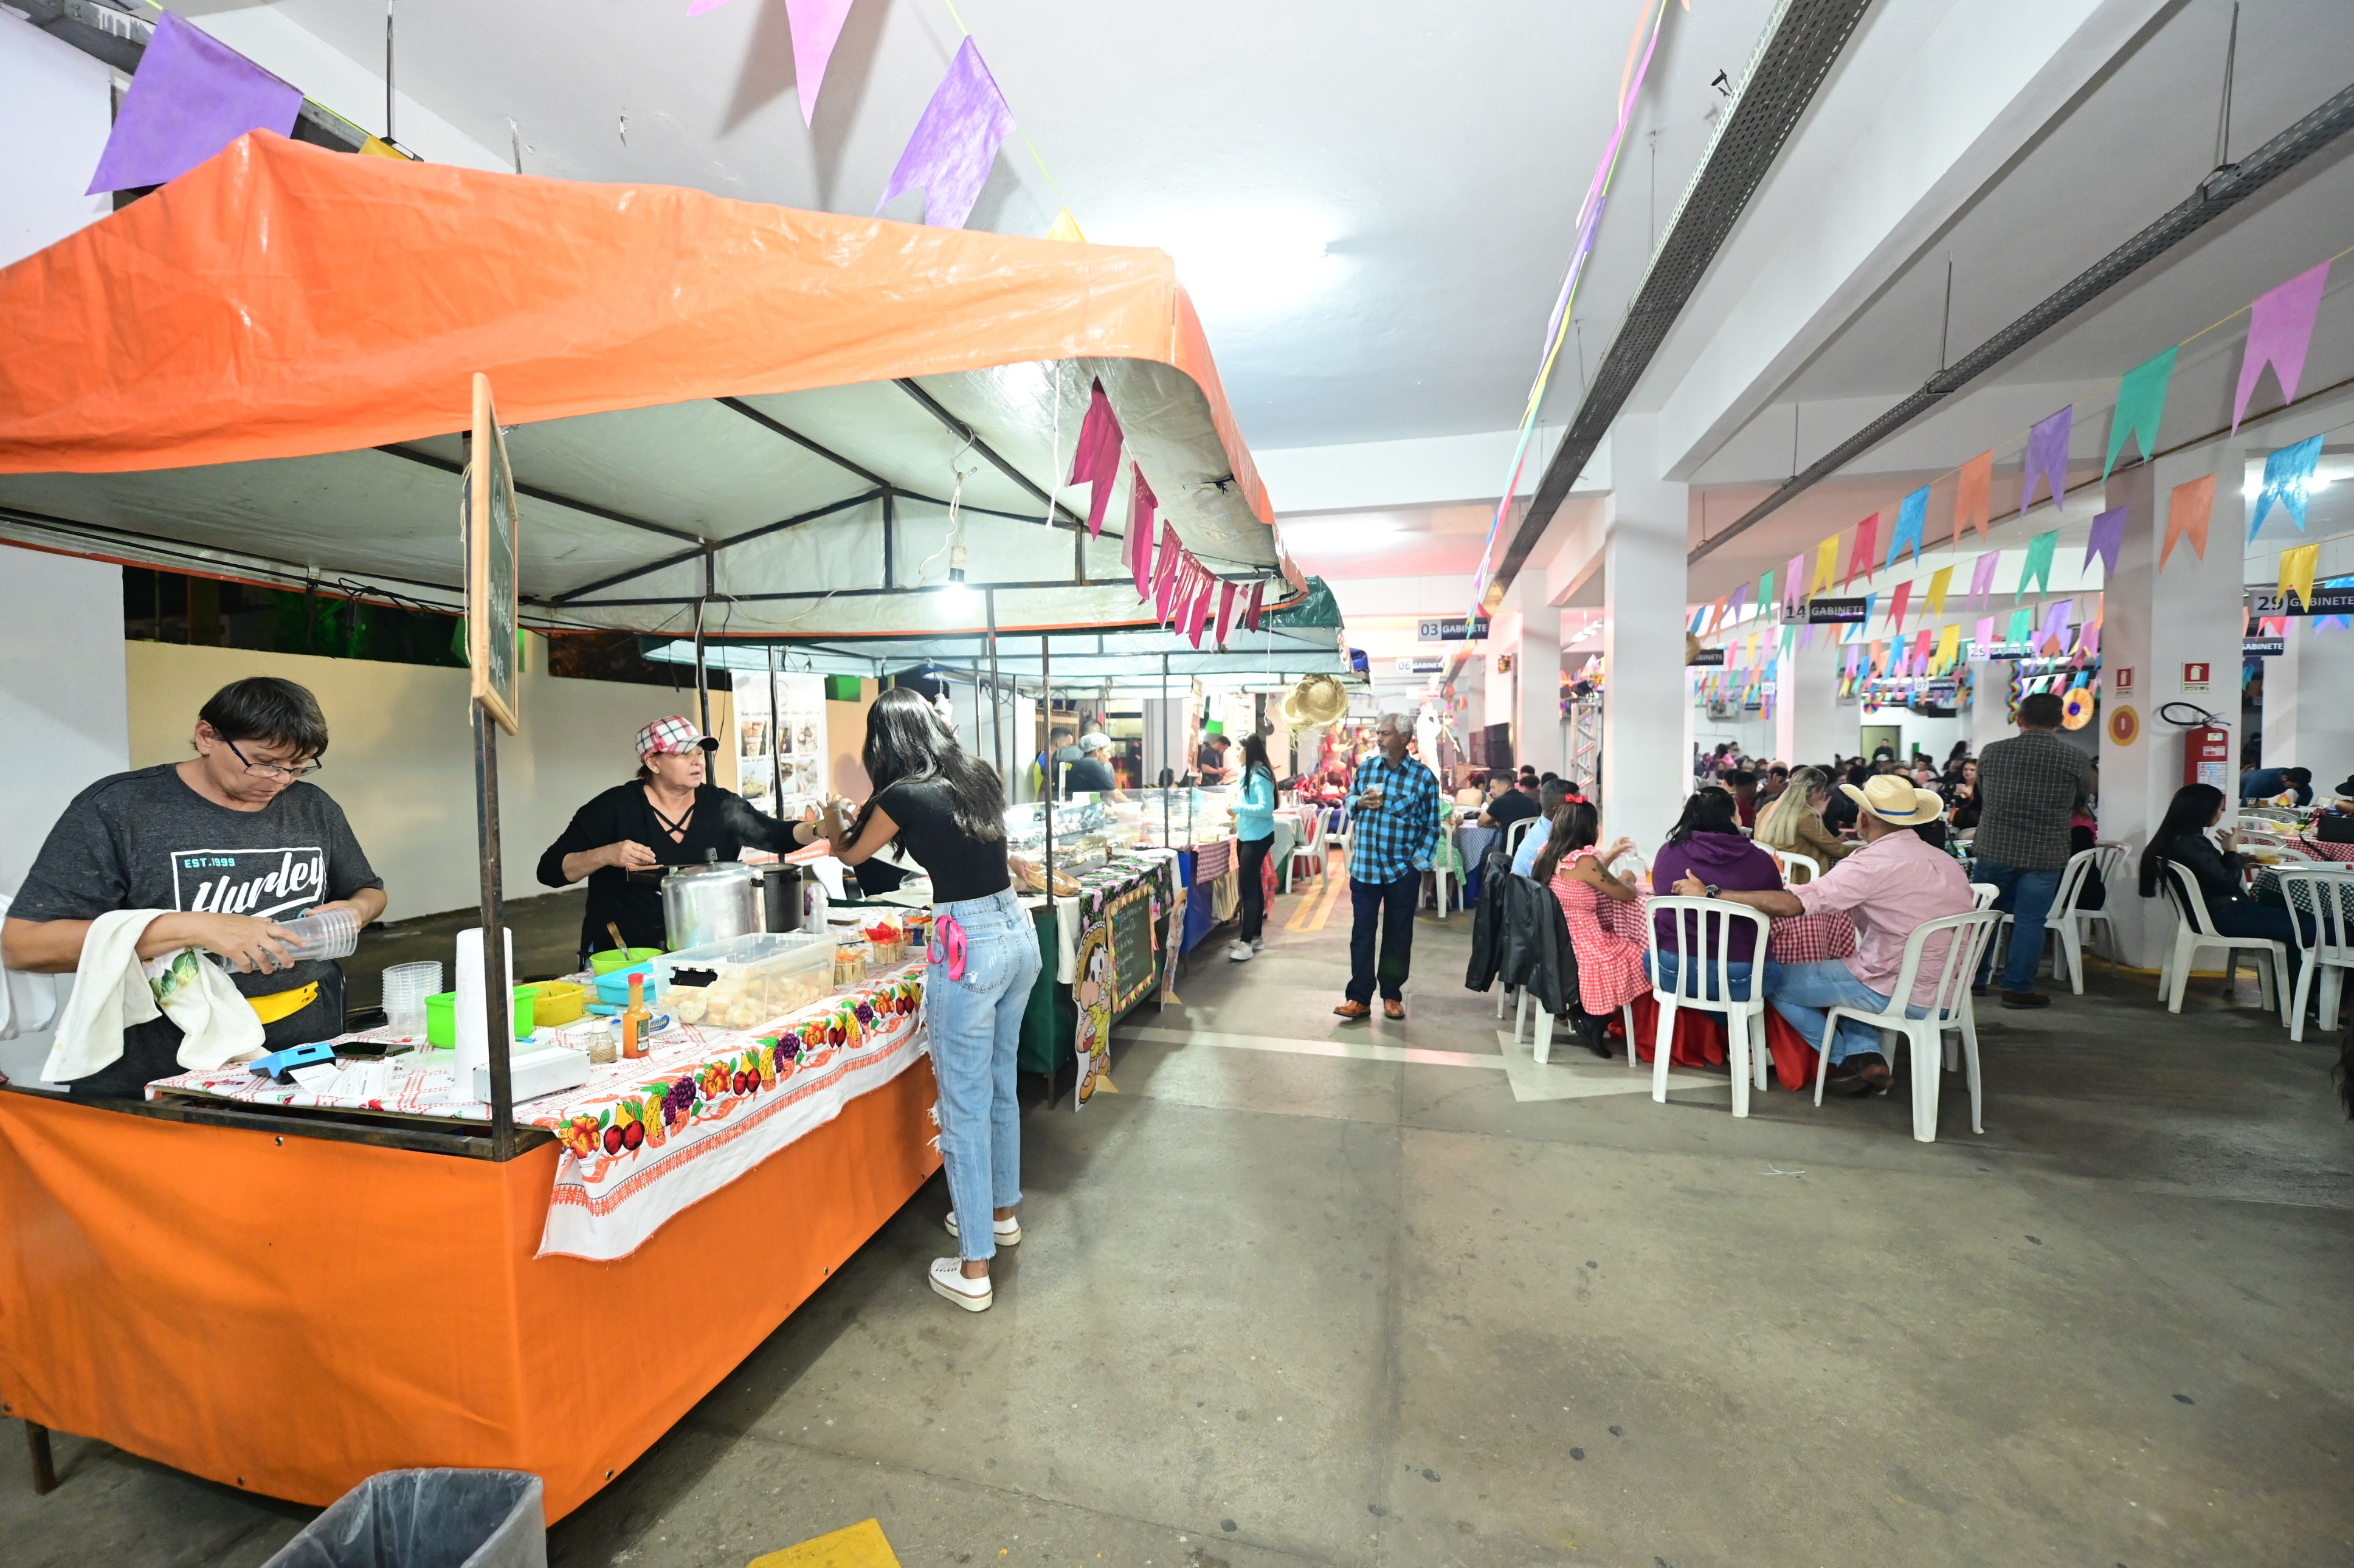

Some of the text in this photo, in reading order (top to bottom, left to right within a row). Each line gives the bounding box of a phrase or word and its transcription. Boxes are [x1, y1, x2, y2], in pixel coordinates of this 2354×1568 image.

[2258, 596, 2284, 610] 29
[1786, 606, 1865, 618] 14 GABINETE
[1421, 624, 1438, 635] 03
[1991, 646, 2032, 655] GAINEE
